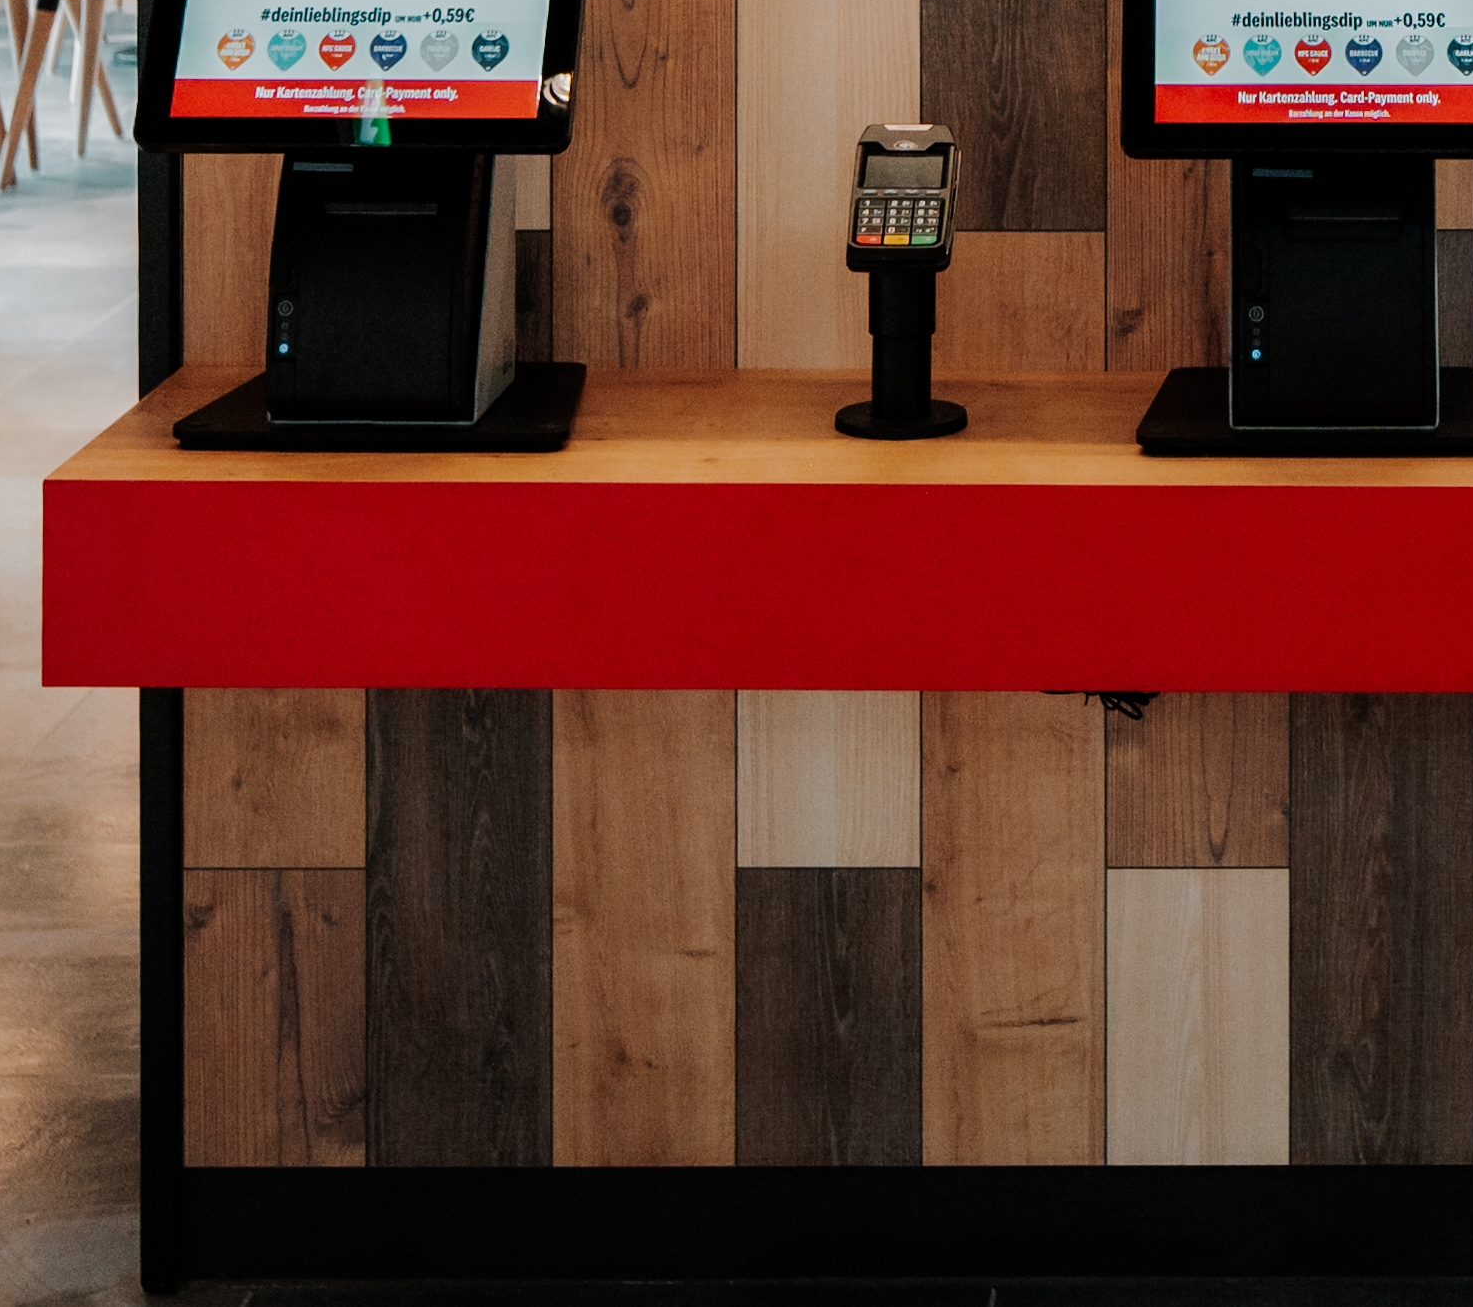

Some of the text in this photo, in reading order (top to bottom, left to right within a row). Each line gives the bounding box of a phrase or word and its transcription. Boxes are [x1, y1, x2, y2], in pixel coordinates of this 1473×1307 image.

[260, 6, 476, 27] #deinlieblingsdip +0,59€
[1231, 11, 1446, 31] #deinlieblingsdip +0,59€
